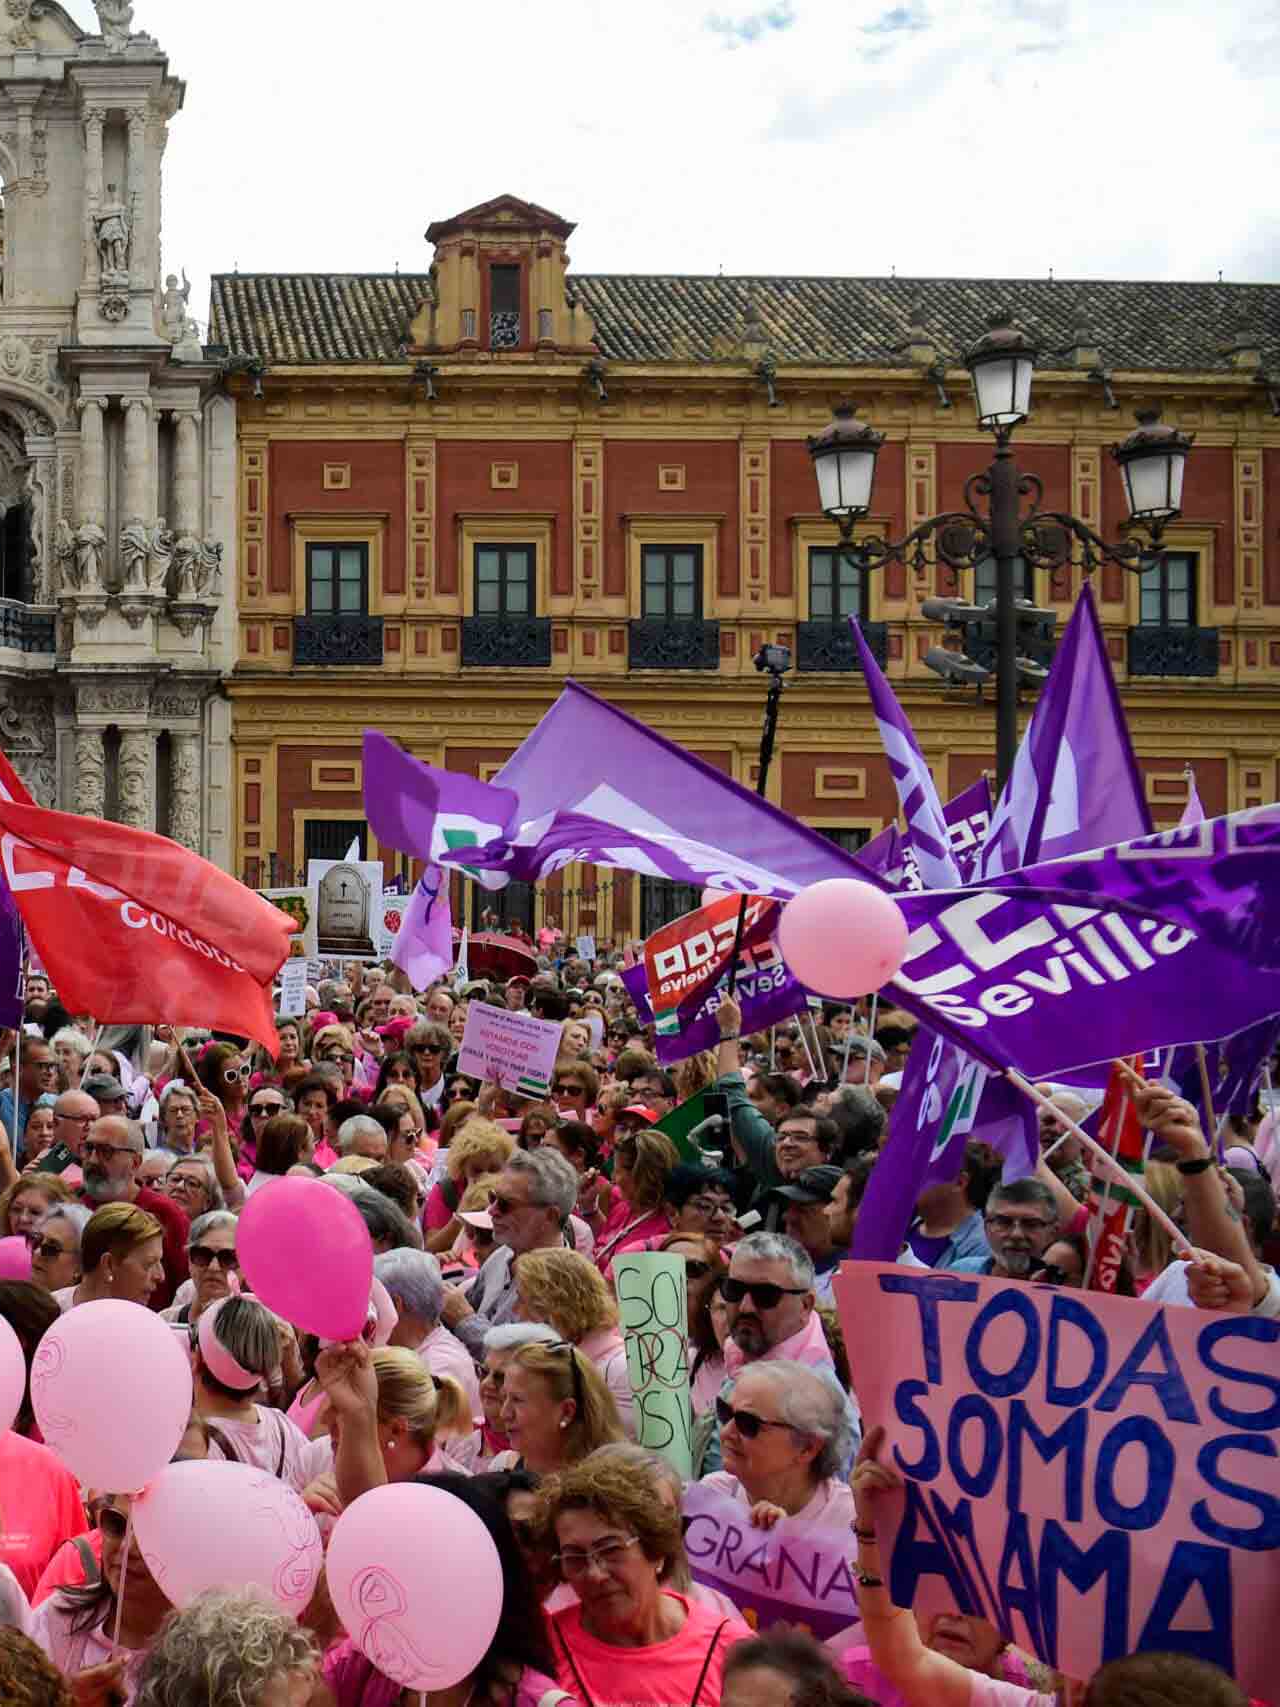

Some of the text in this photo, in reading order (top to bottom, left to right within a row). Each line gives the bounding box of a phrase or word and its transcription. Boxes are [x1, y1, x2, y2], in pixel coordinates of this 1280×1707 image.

[922, 911, 1197, 1028] Sevilla
[878, 1273, 1280, 1430] TODAS
[892, 1379, 1280, 1551] SOMOS
